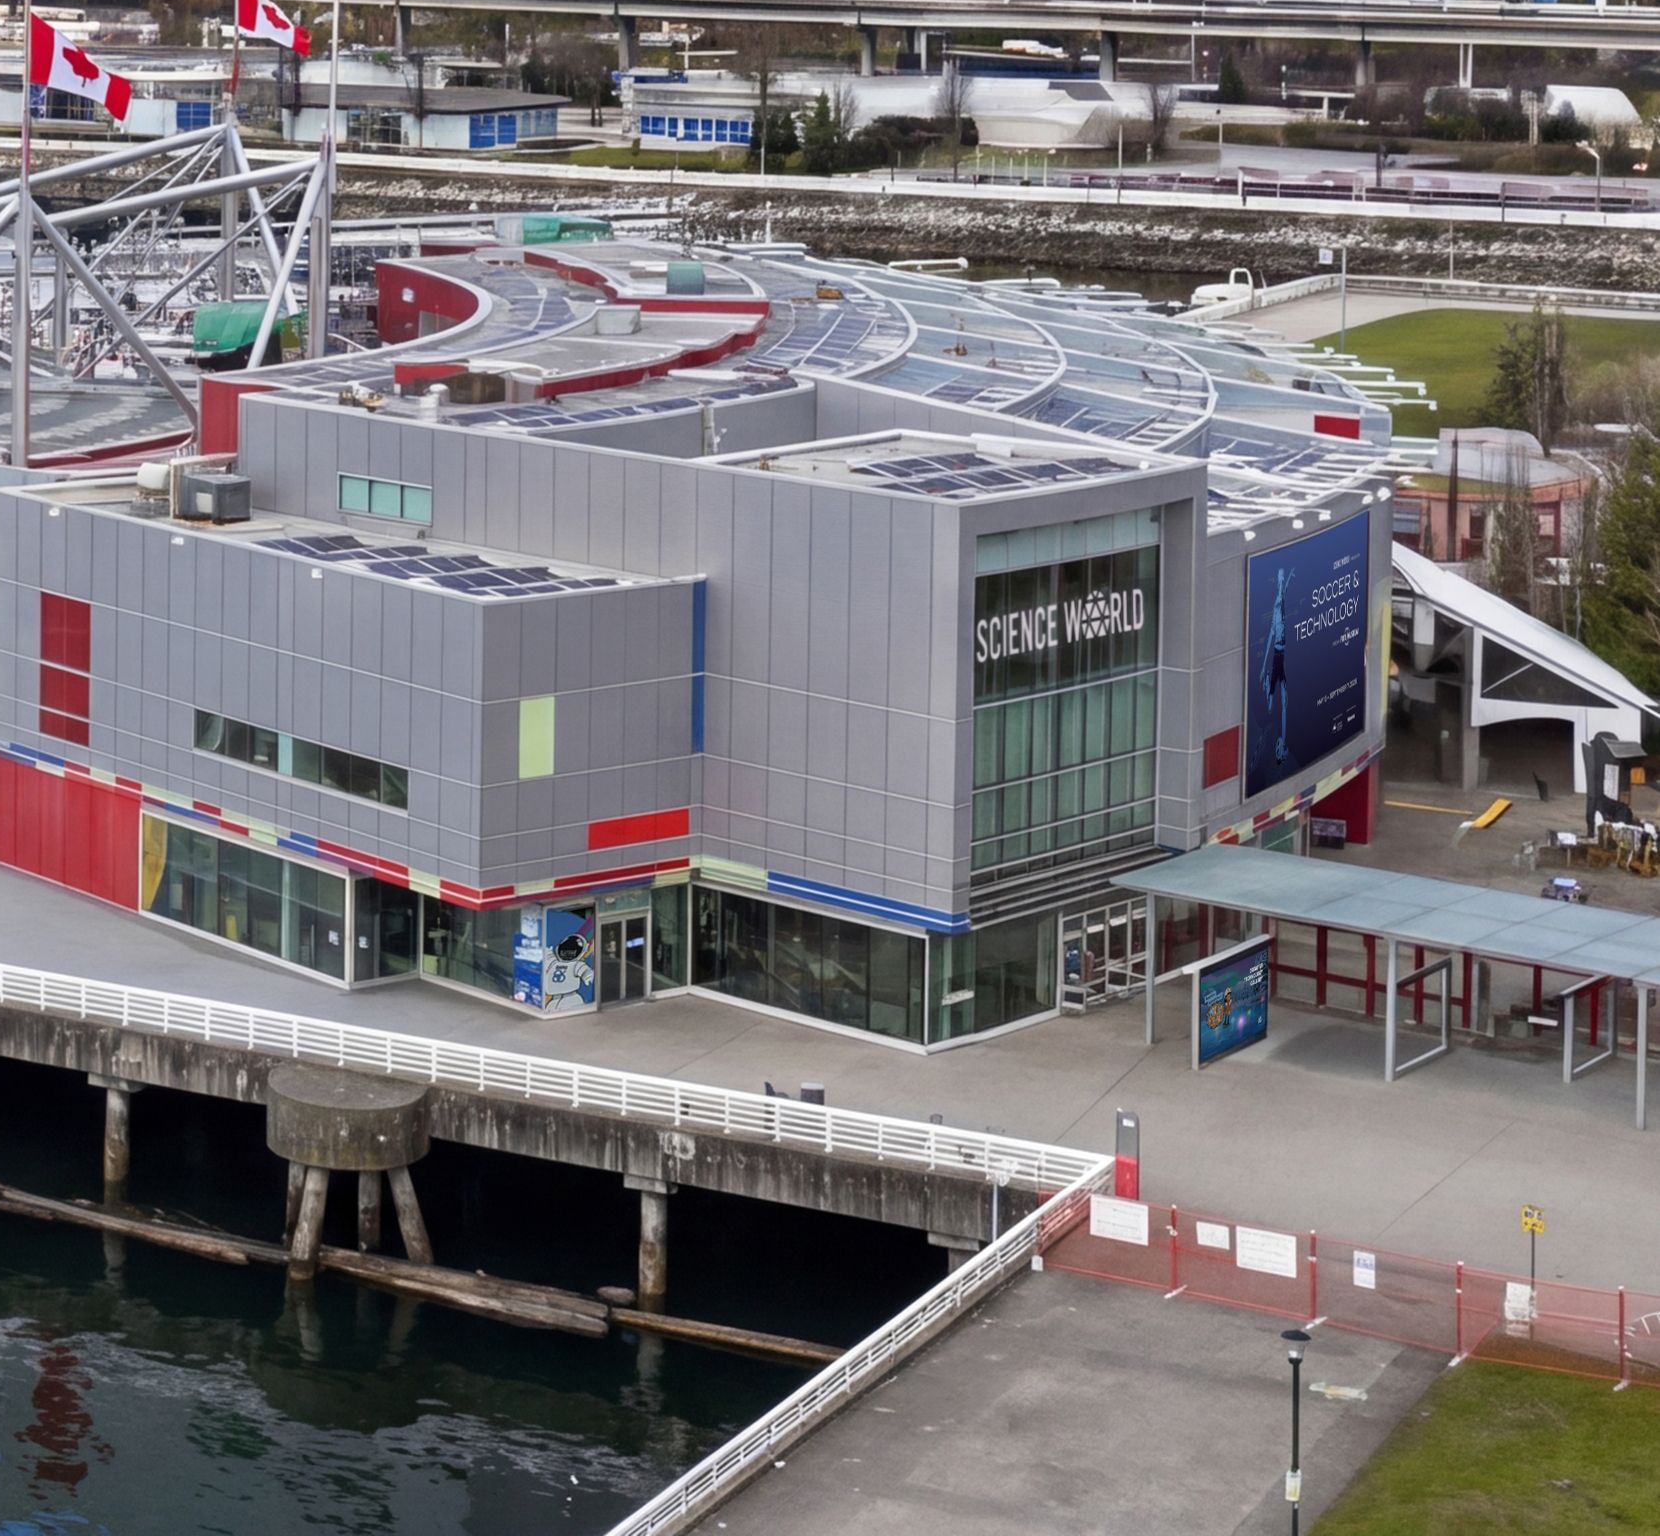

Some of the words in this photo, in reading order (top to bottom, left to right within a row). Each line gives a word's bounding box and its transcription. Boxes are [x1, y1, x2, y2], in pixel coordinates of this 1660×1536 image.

[1311, 573, 1351, 608] SOCCER
[1353, 569, 1360, 589] &
[976, 604, 1058, 663] SCIENCE
[1064, 588, 1144, 644] WORLD
[1294, 594, 1360, 643] TECHNOLOGY
